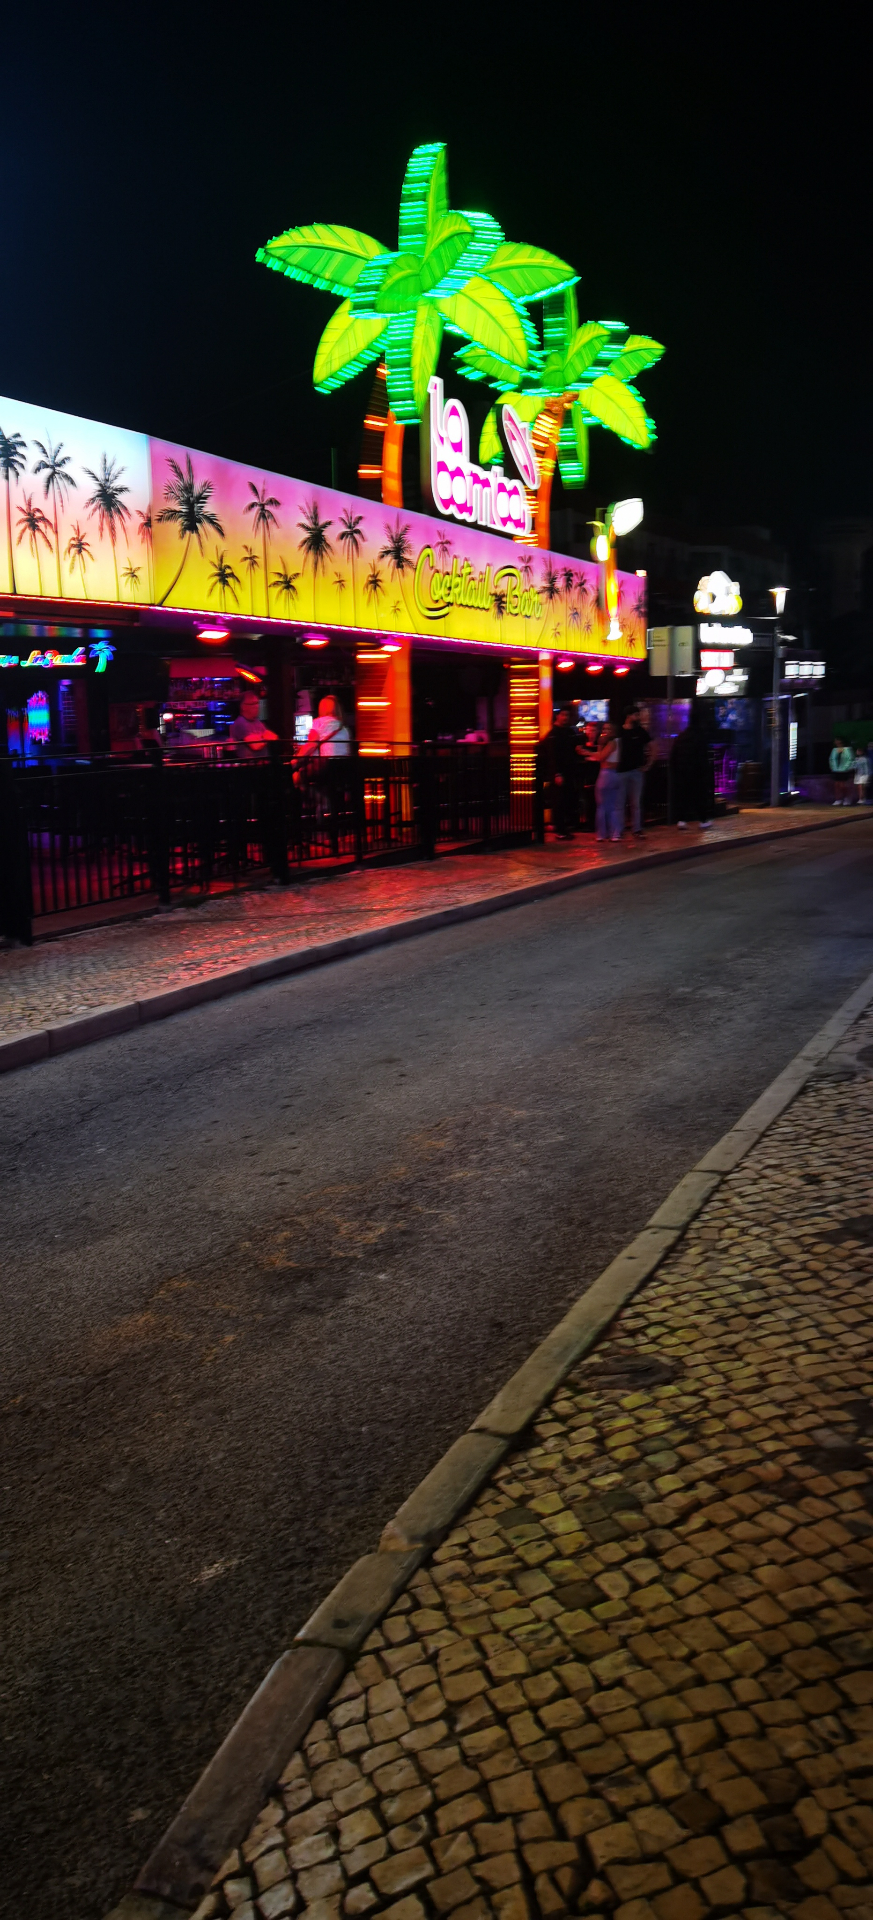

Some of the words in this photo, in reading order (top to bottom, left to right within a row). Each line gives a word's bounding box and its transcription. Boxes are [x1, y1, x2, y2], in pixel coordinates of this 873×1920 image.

[431, 455, 532, 536] bamba
[414, 545, 494, 620] Cocktail
[494, 565, 542, 620] Bar
